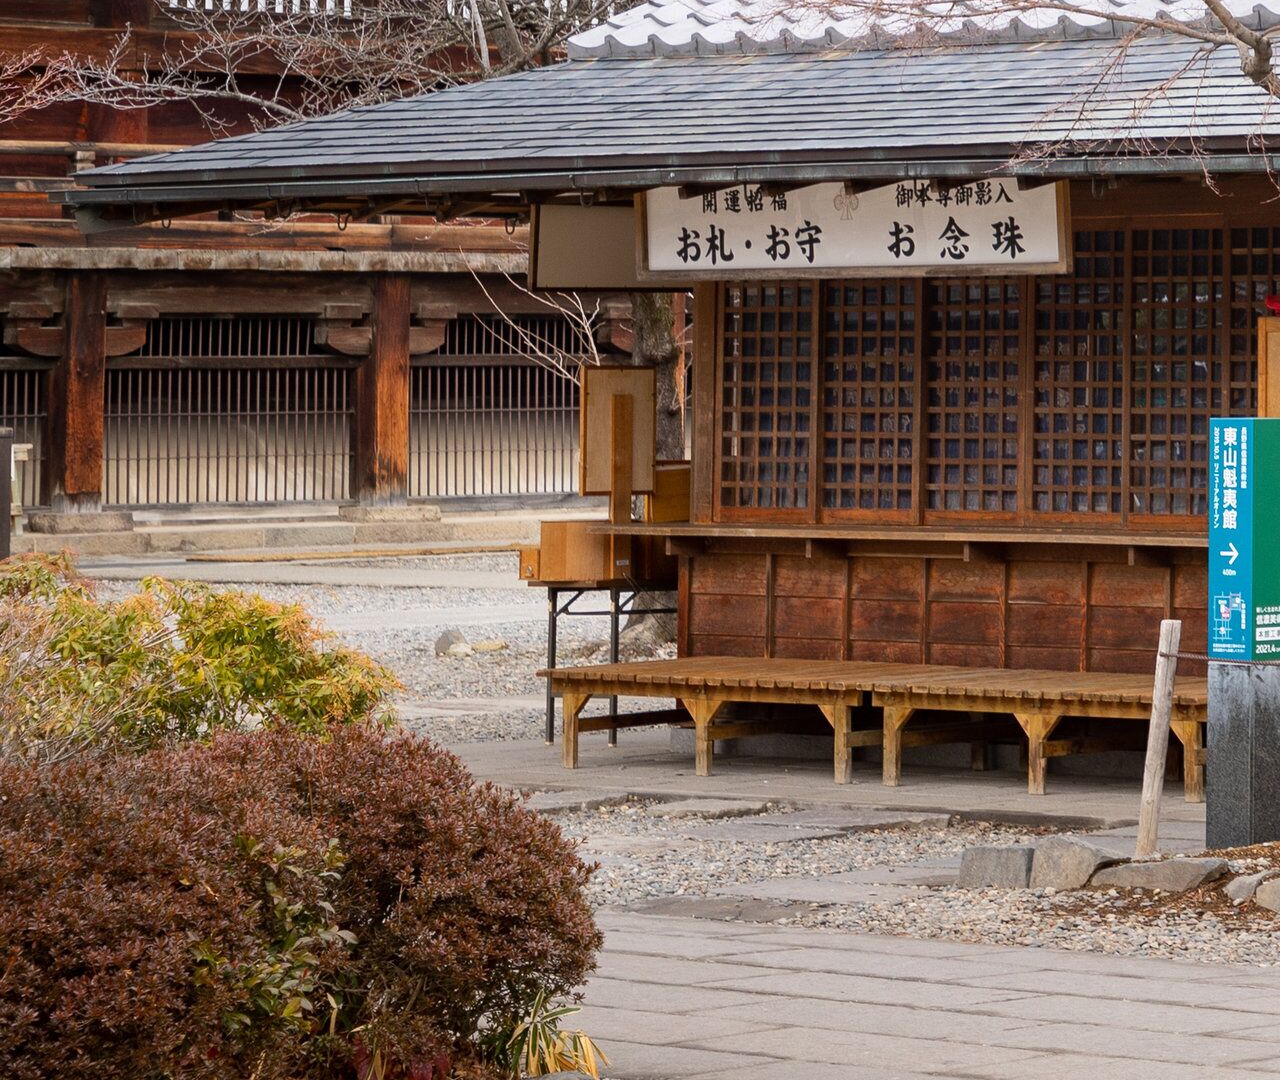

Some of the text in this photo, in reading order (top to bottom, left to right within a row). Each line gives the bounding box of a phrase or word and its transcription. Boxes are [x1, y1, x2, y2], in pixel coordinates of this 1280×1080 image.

[676, 220, 823, 265] お札・お守
[887, 216, 1026, 260] お念珠
[1222, 427, 1238, 529] 東山魁夷館
[1256, 644, 1276, 654] 2021.4
